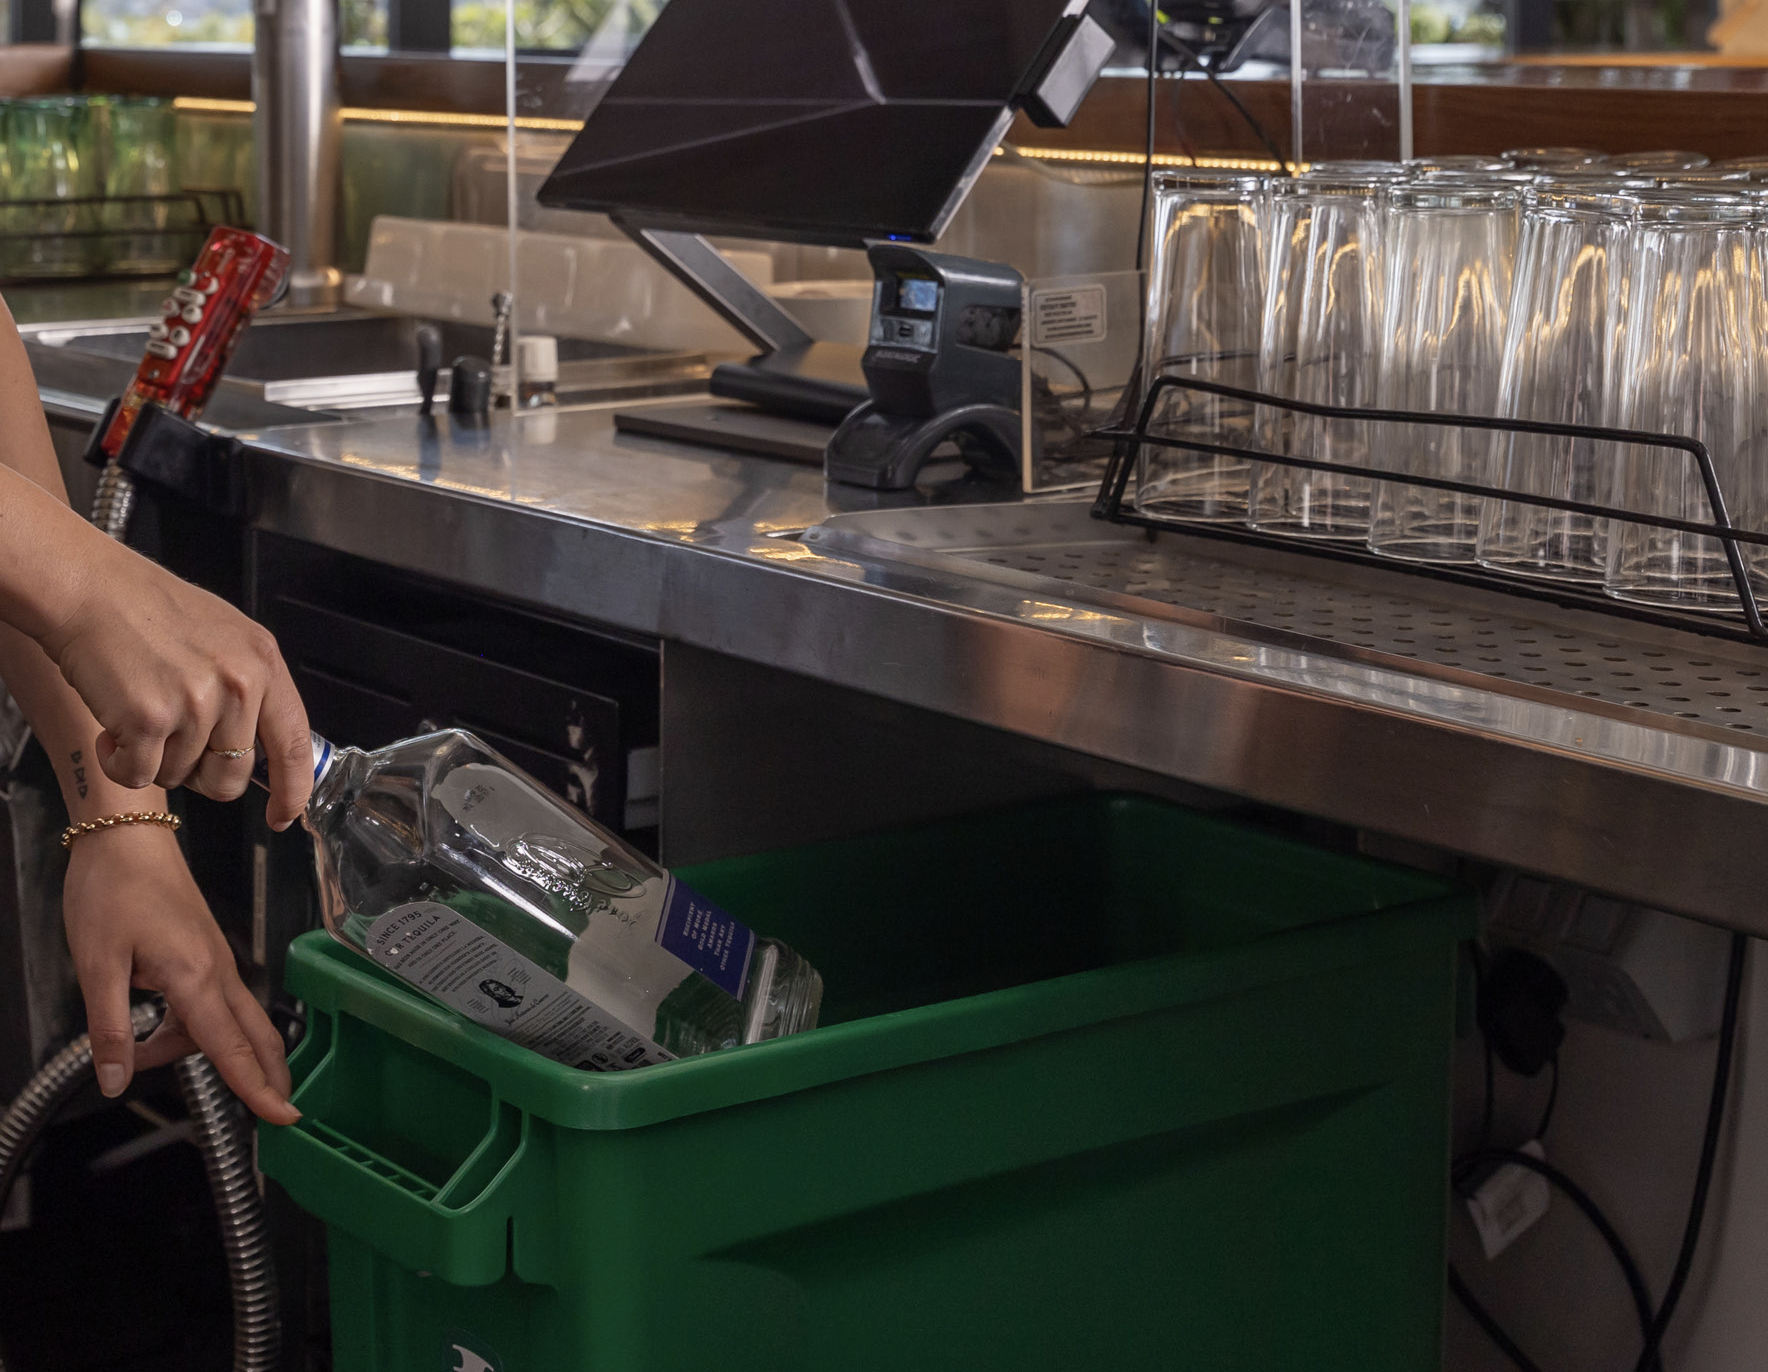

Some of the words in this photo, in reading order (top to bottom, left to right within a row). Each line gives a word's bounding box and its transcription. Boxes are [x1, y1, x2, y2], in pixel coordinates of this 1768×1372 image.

[376, 922, 400, 945] SINCE
[398, 910, 422, 925] 1795
[384, 942, 405, 957] OR
[402, 915, 441, 943] TEQUILA
